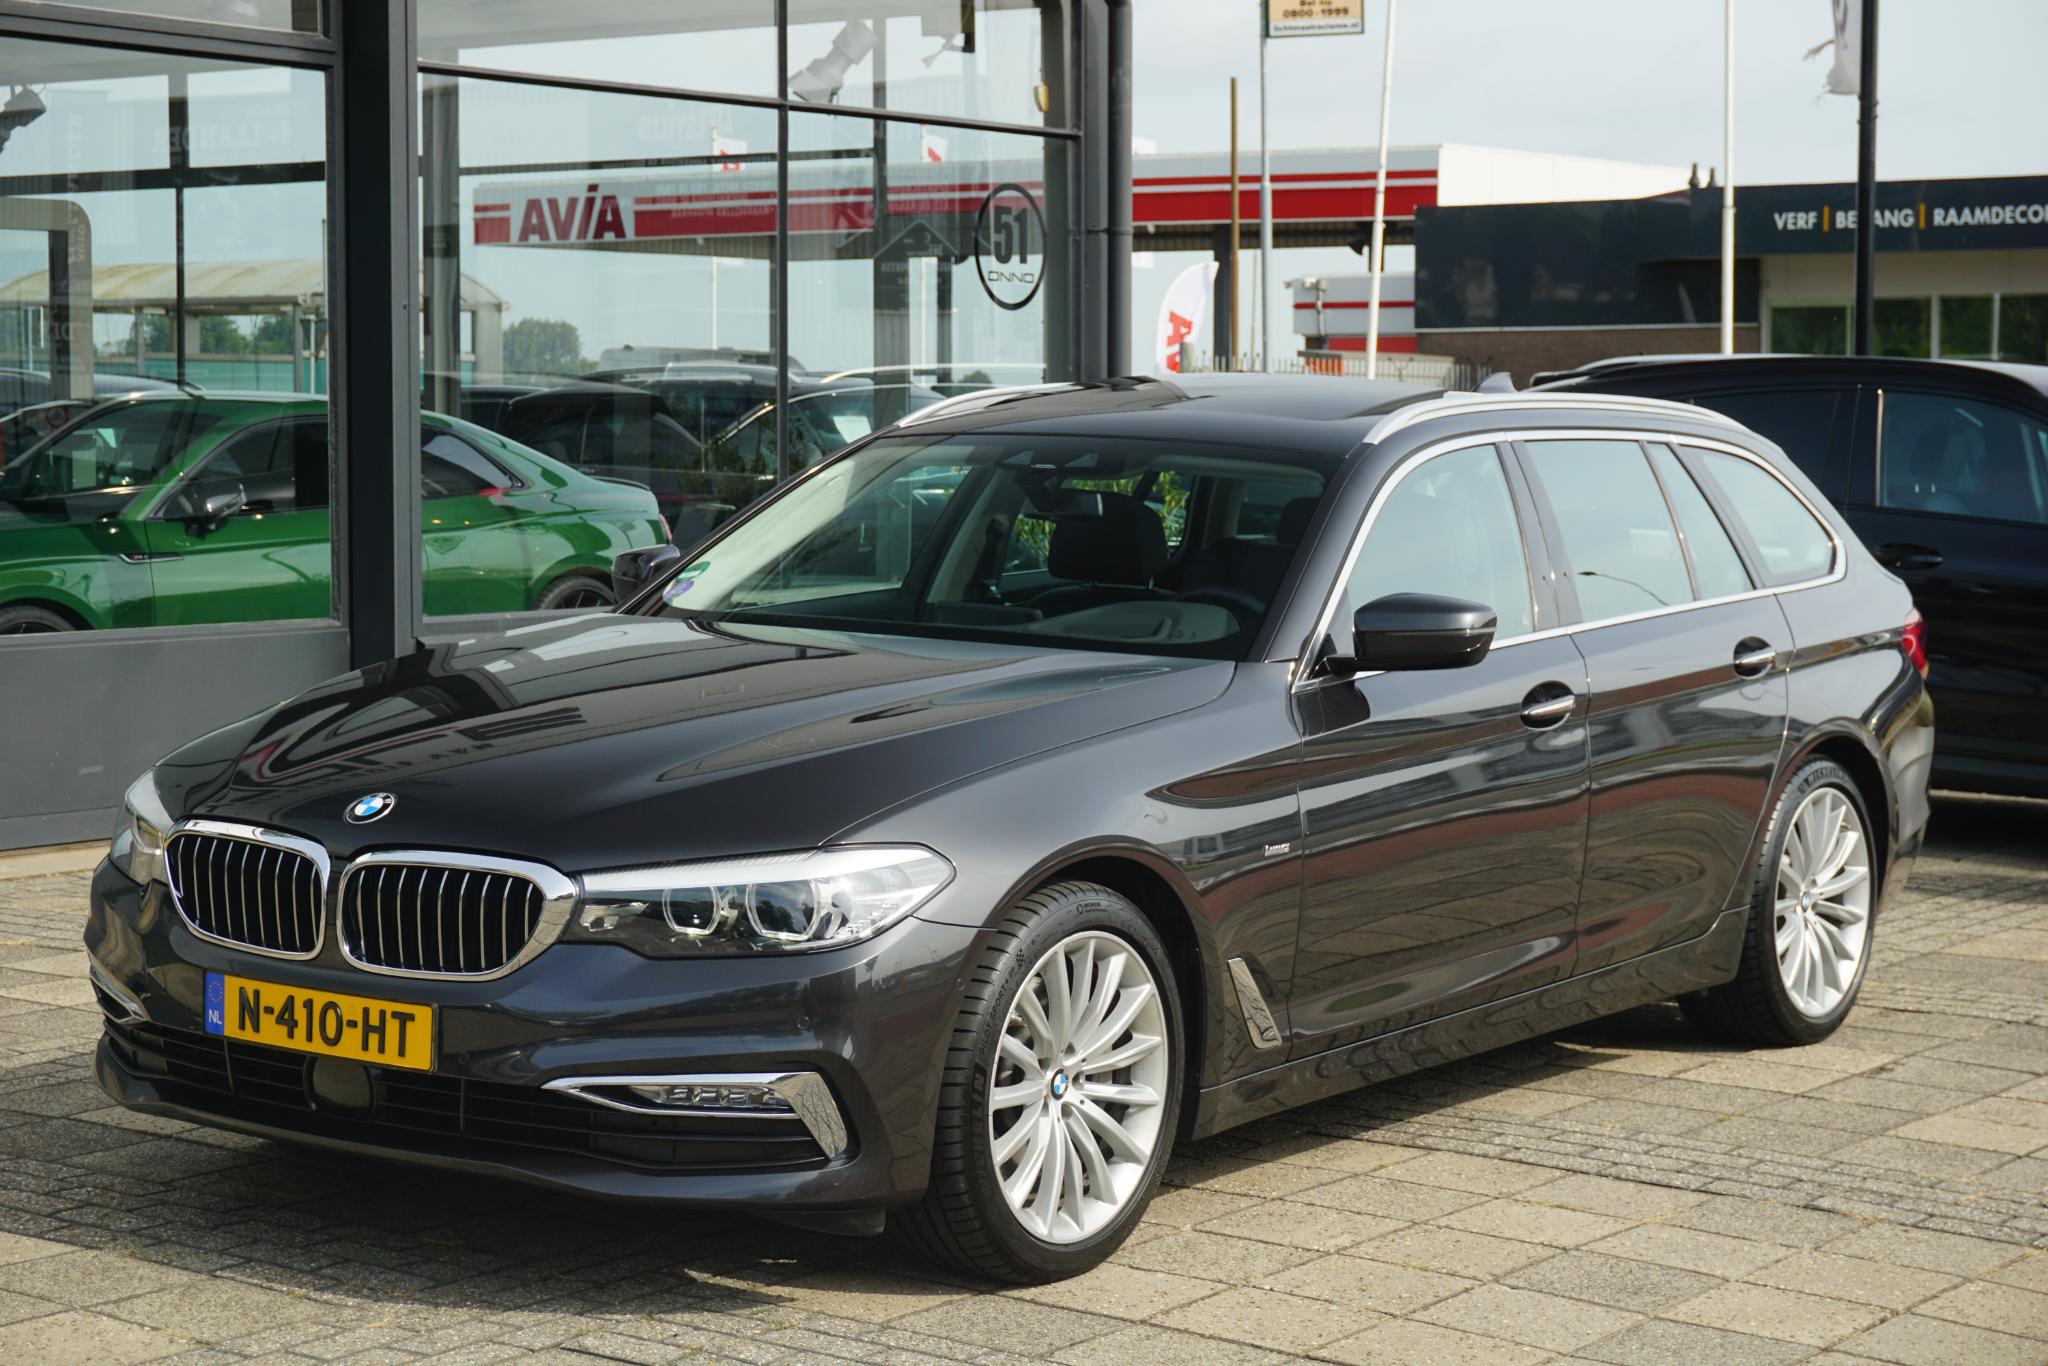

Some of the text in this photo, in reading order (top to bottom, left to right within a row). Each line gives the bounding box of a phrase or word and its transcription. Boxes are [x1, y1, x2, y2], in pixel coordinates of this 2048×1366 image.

[993, 204, 1028, 265] 51
[1773, 204, 2048, 230] VERF BEANG RAAMDECO
[208, 1008, 223, 1025] NL
[238, 986, 415, 1058] N-410-HT
